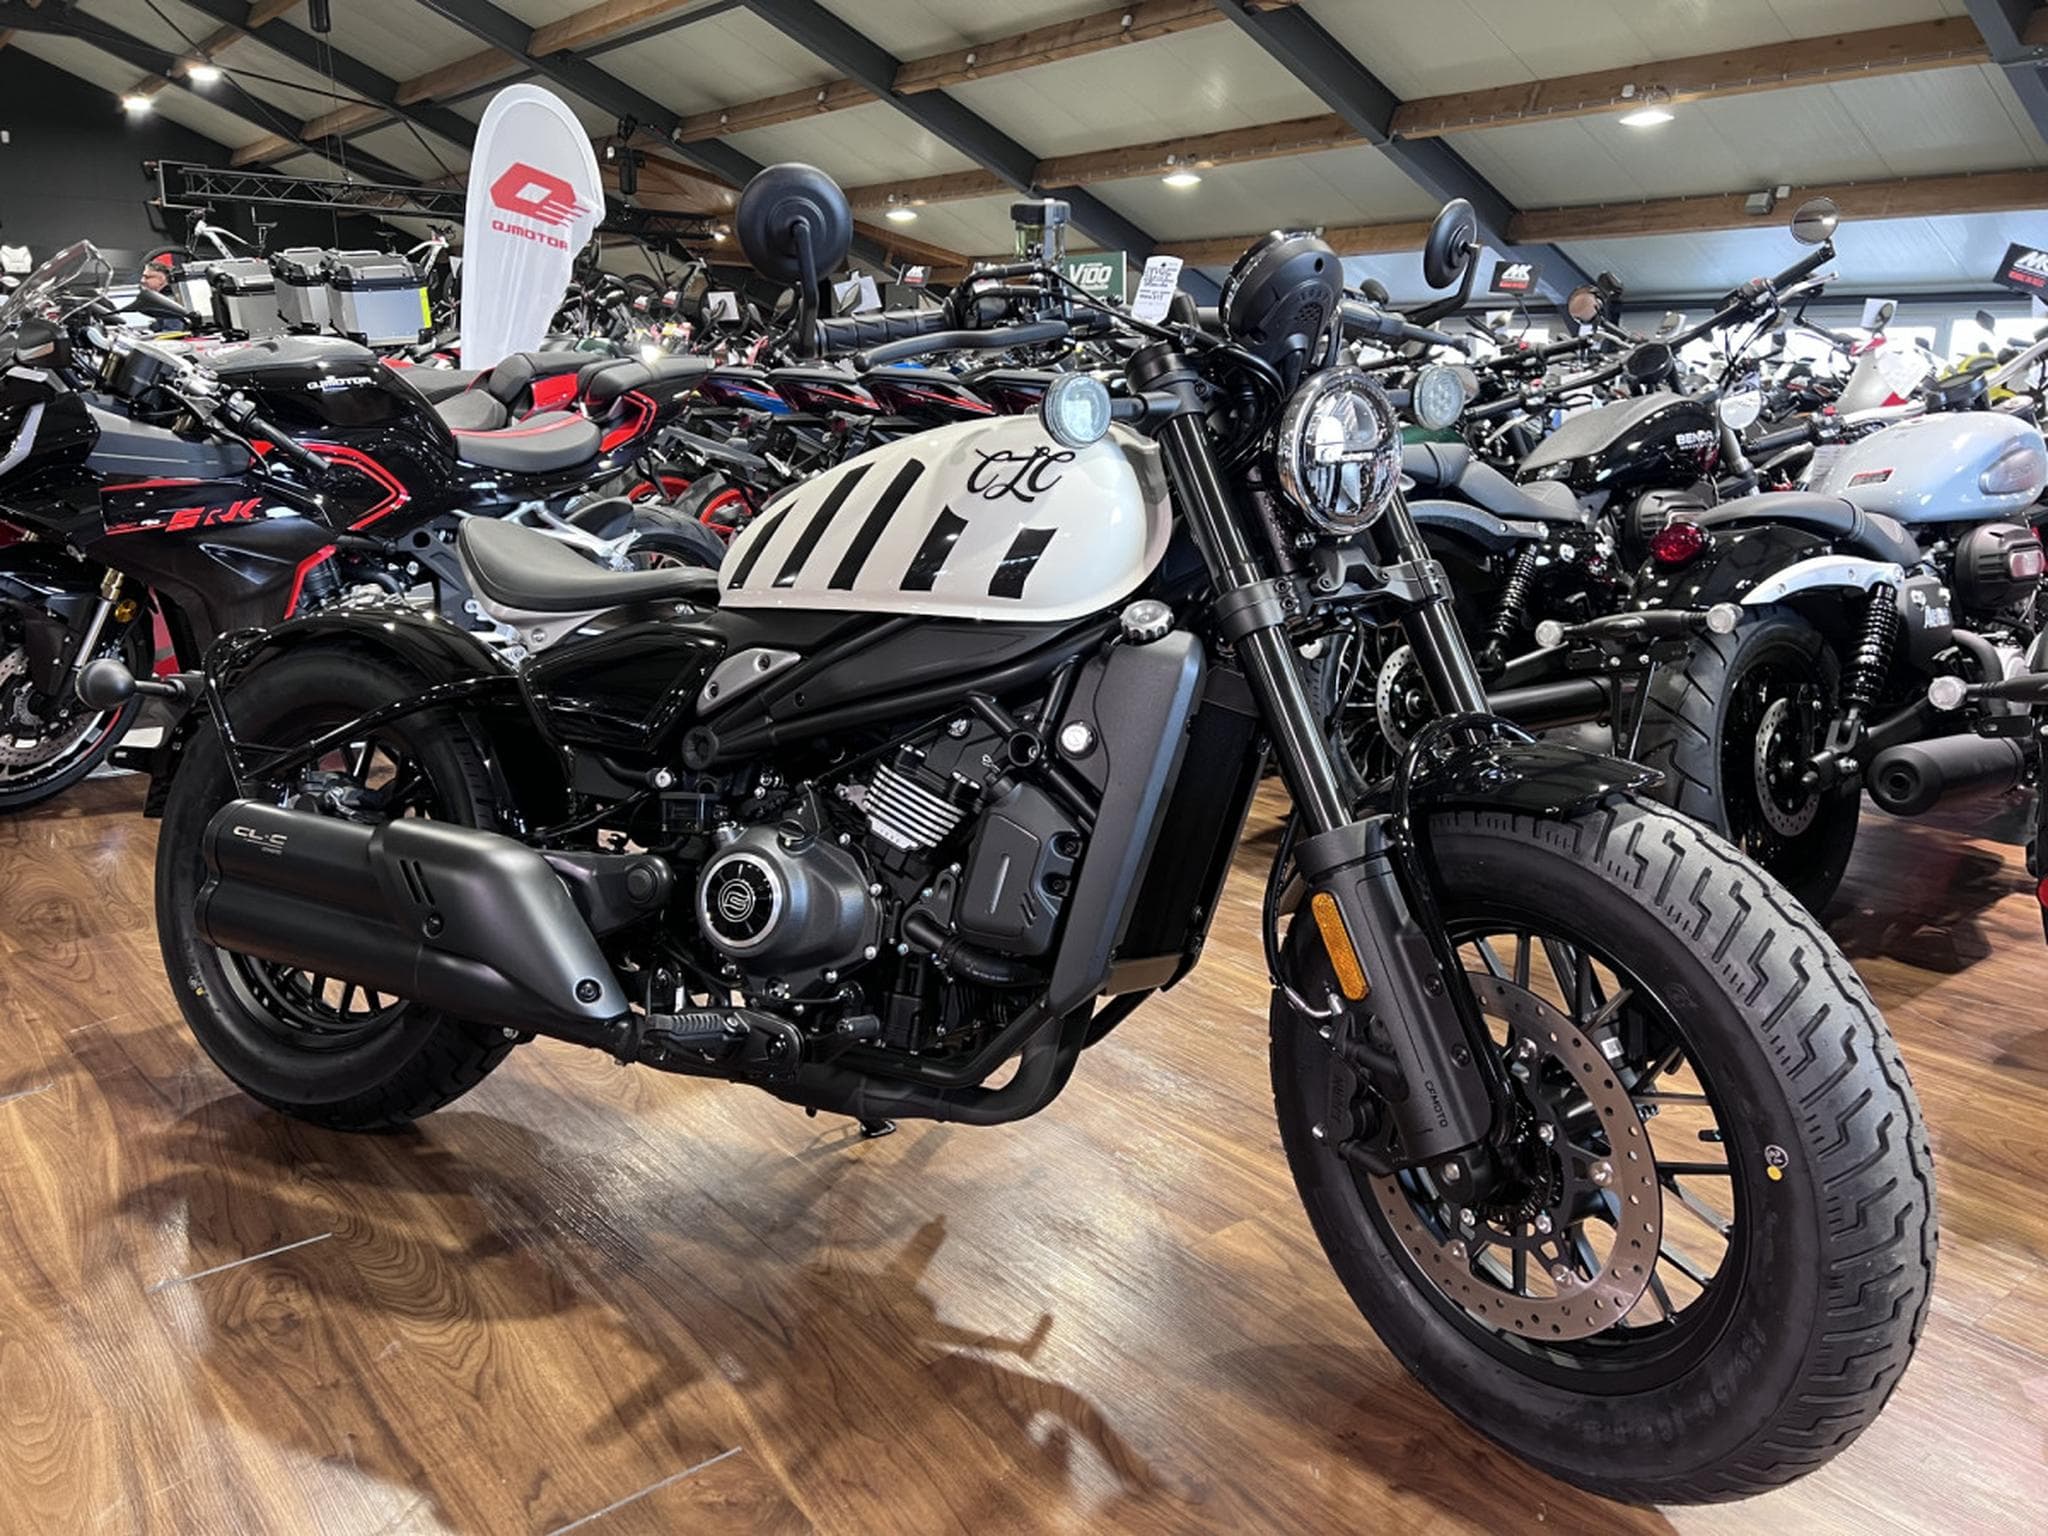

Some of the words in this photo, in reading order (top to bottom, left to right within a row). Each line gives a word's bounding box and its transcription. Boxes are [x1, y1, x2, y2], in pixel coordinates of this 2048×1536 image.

[491, 219, 568, 251] QJMOTOR
[1069, 263, 1113, 284] V100
[967, 446, 1076, 503] CLC
